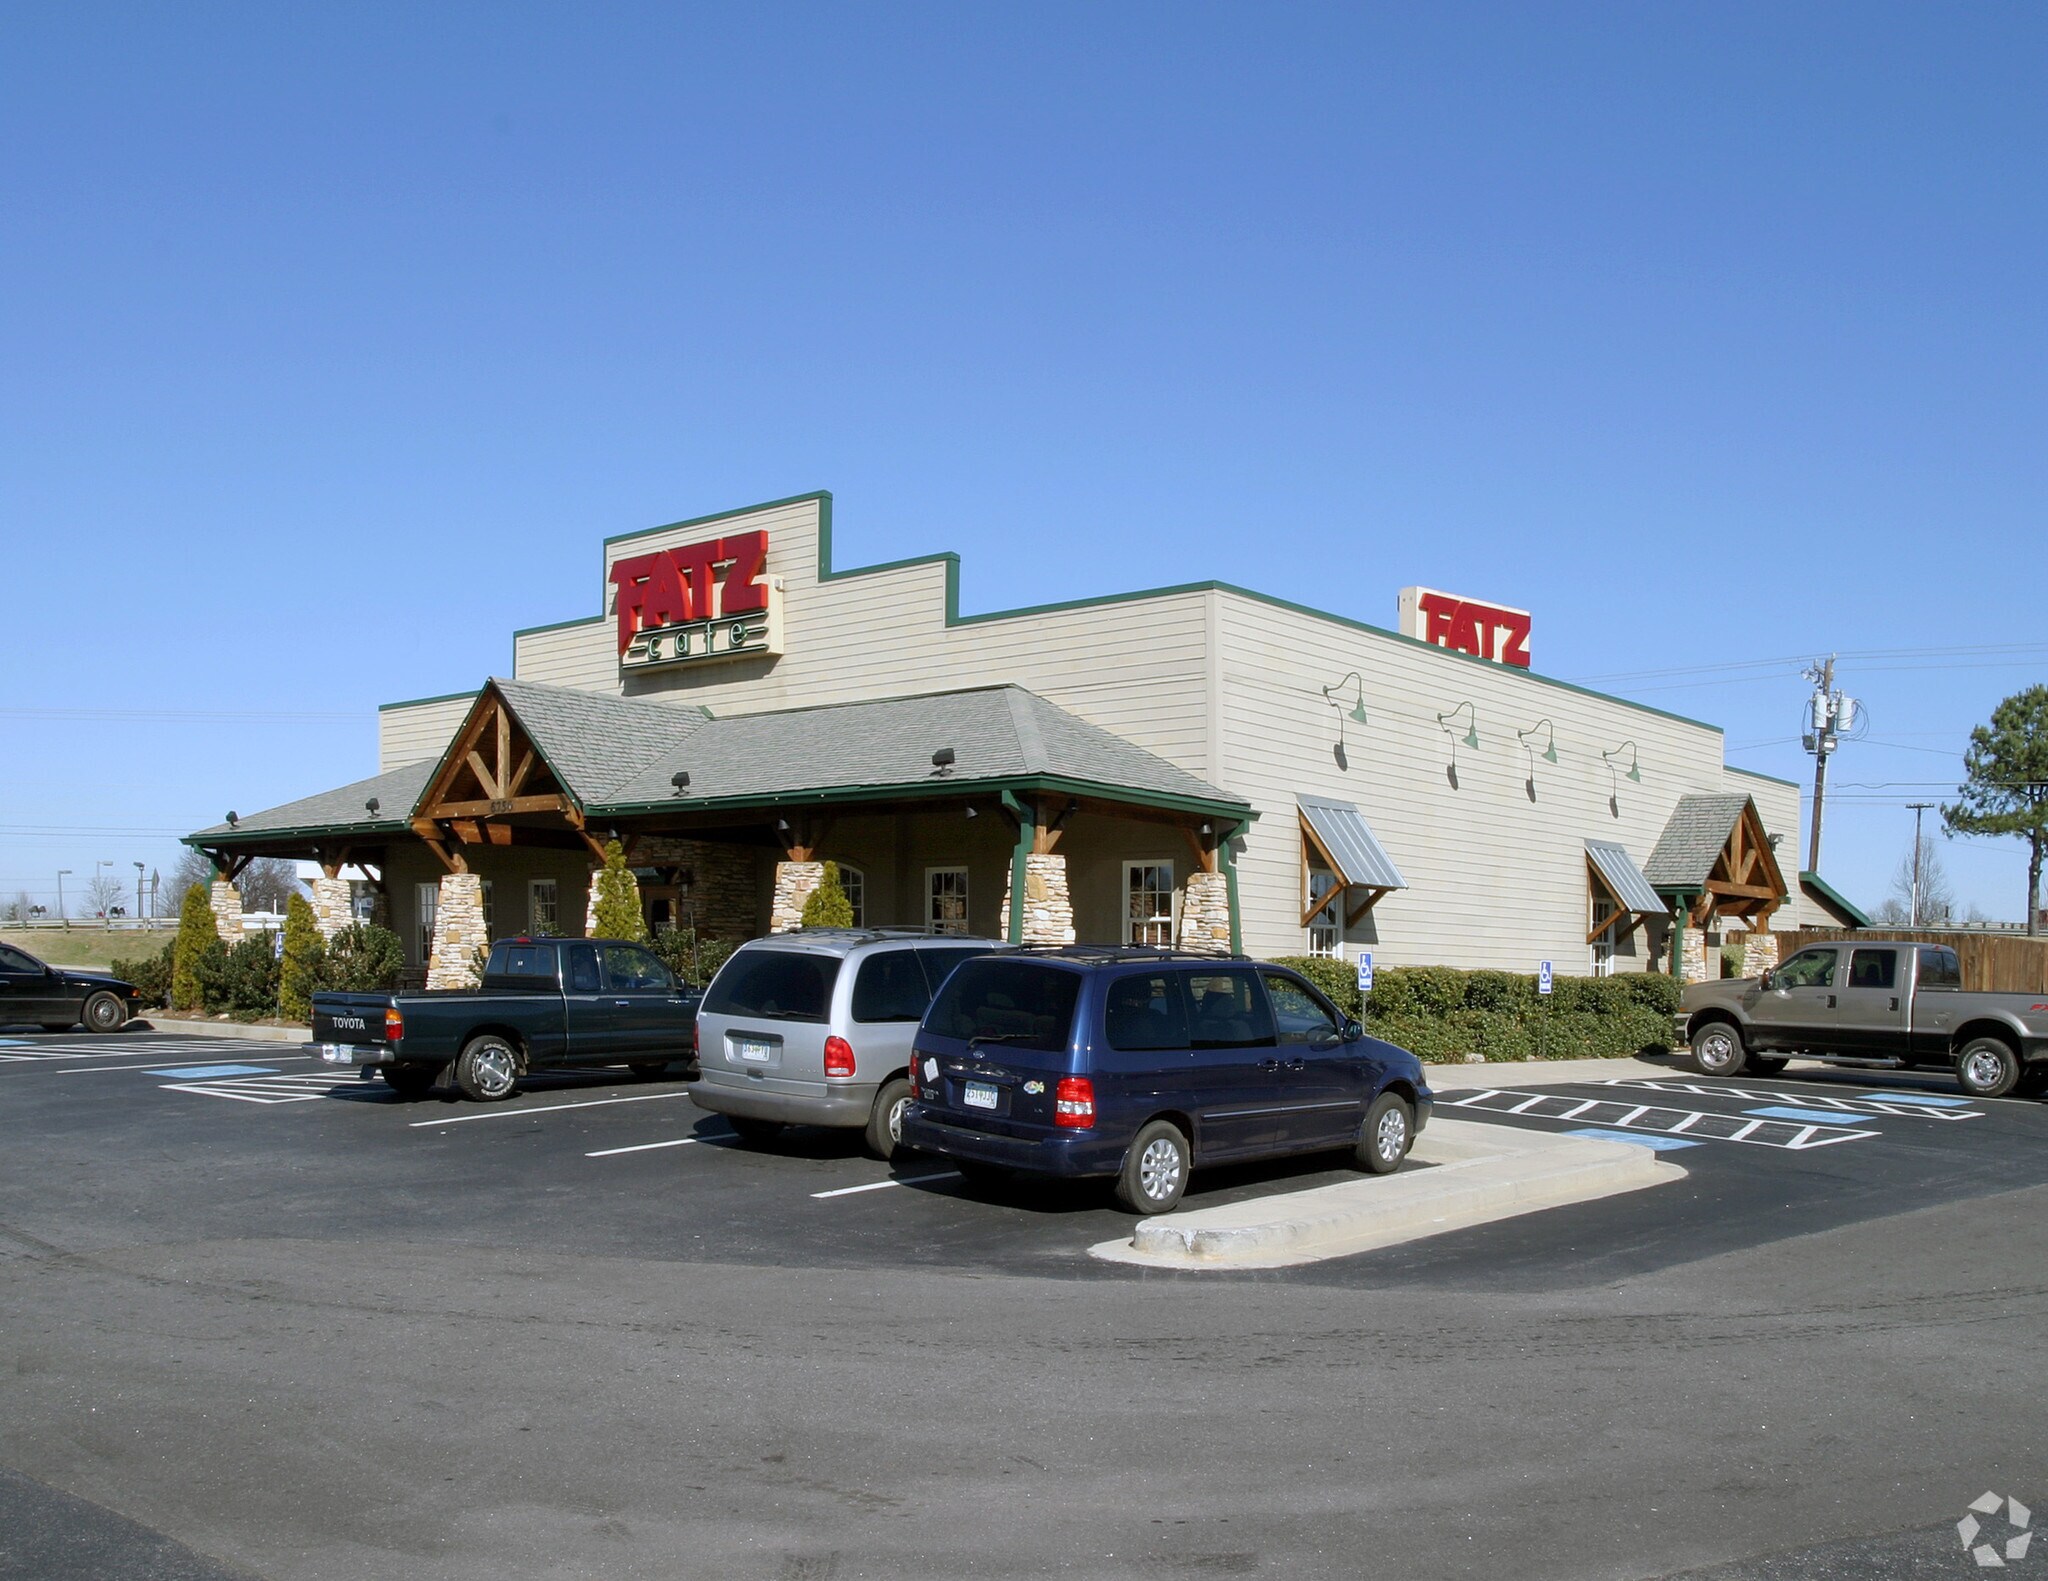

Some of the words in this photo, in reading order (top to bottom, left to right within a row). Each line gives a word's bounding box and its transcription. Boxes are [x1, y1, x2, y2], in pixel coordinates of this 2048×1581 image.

[608, 529, 768, 657] FATZ
[648, 620, 747, 661] cafe
[1418, 593, 1531, 667] FATZ
[332, 1017, 365, 1030] TOYOTA
